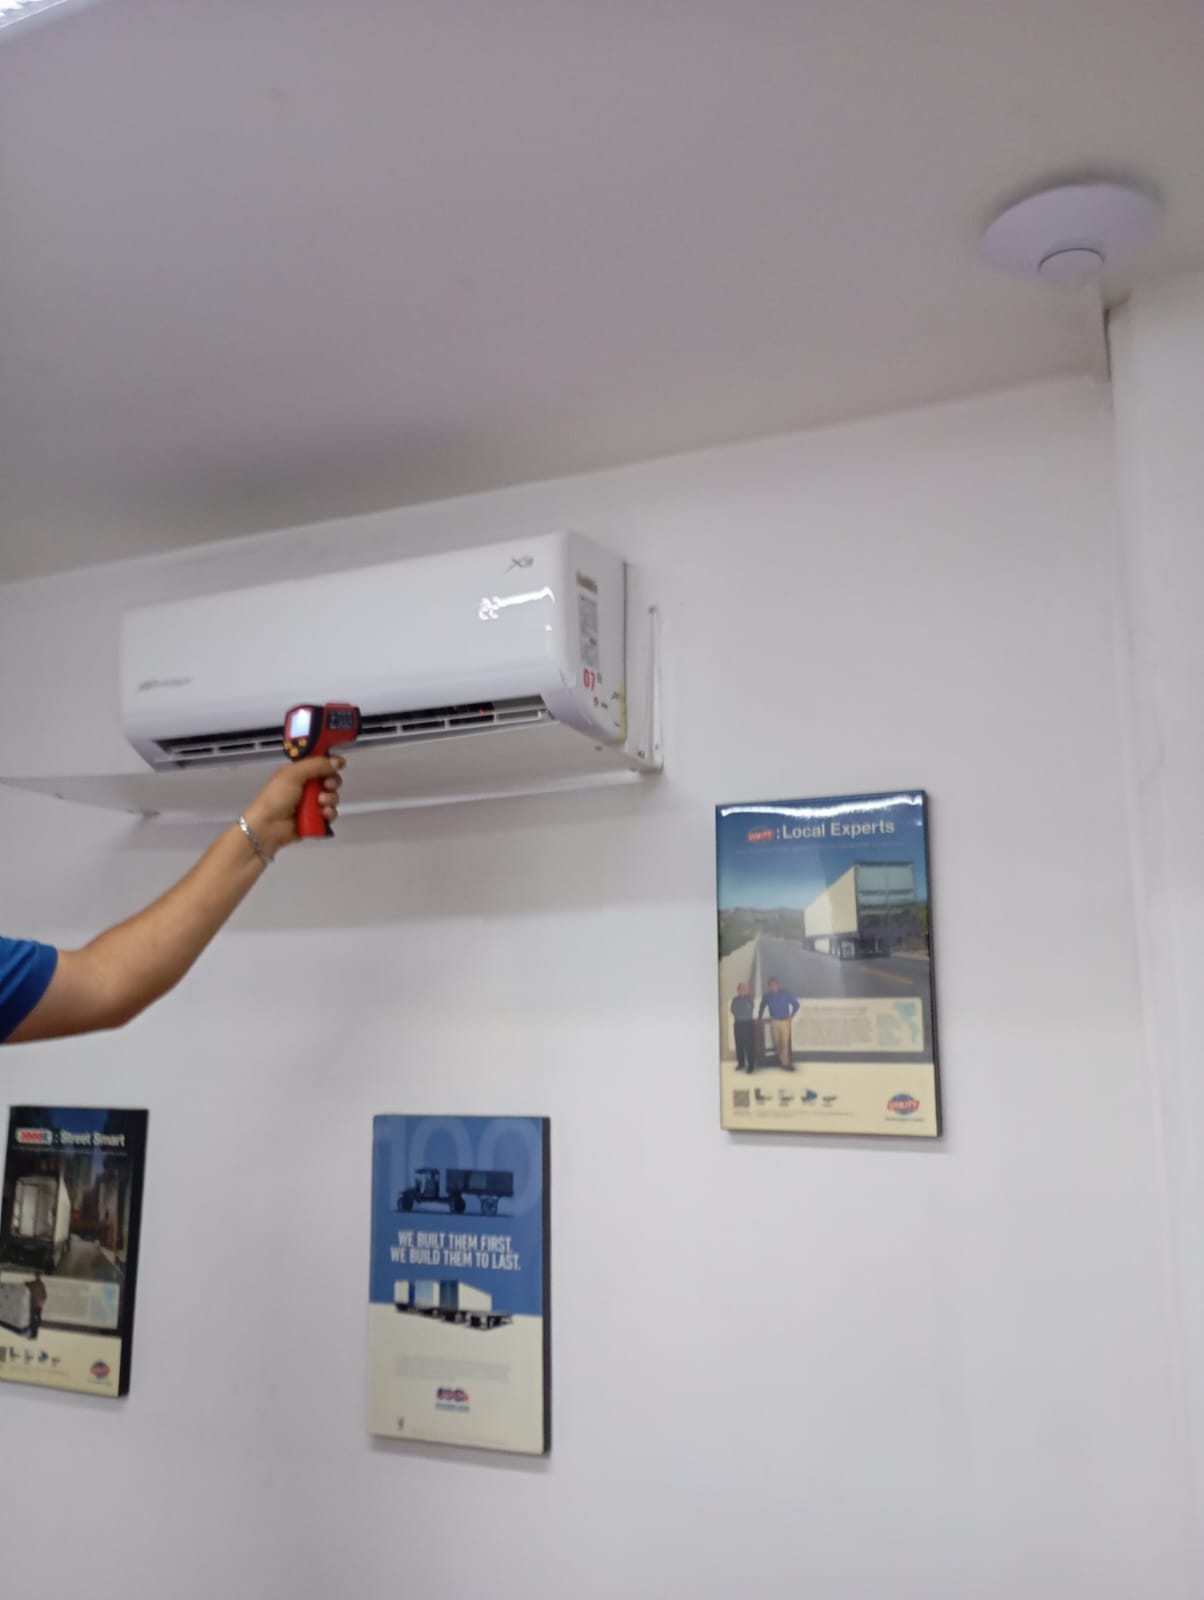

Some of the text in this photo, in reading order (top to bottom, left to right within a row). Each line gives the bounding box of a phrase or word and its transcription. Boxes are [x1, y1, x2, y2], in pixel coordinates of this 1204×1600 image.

[830, 819, 896, 838] Experts
[60, 1129, 91, 1145] Street
[93, 1131, 125, 1147] Smart
[398, 1229, 415, 1247] WE
[417, 1230, 445, 1249] BUILT
[448, 1232, 478, 1250] THEM
[390, 1246, 407, 1263] WE
[409, 1247, 440, 1265] BUILD
[444, 1249, 473, 1267] THEM
[476, 1251, 489, 1268] TO
